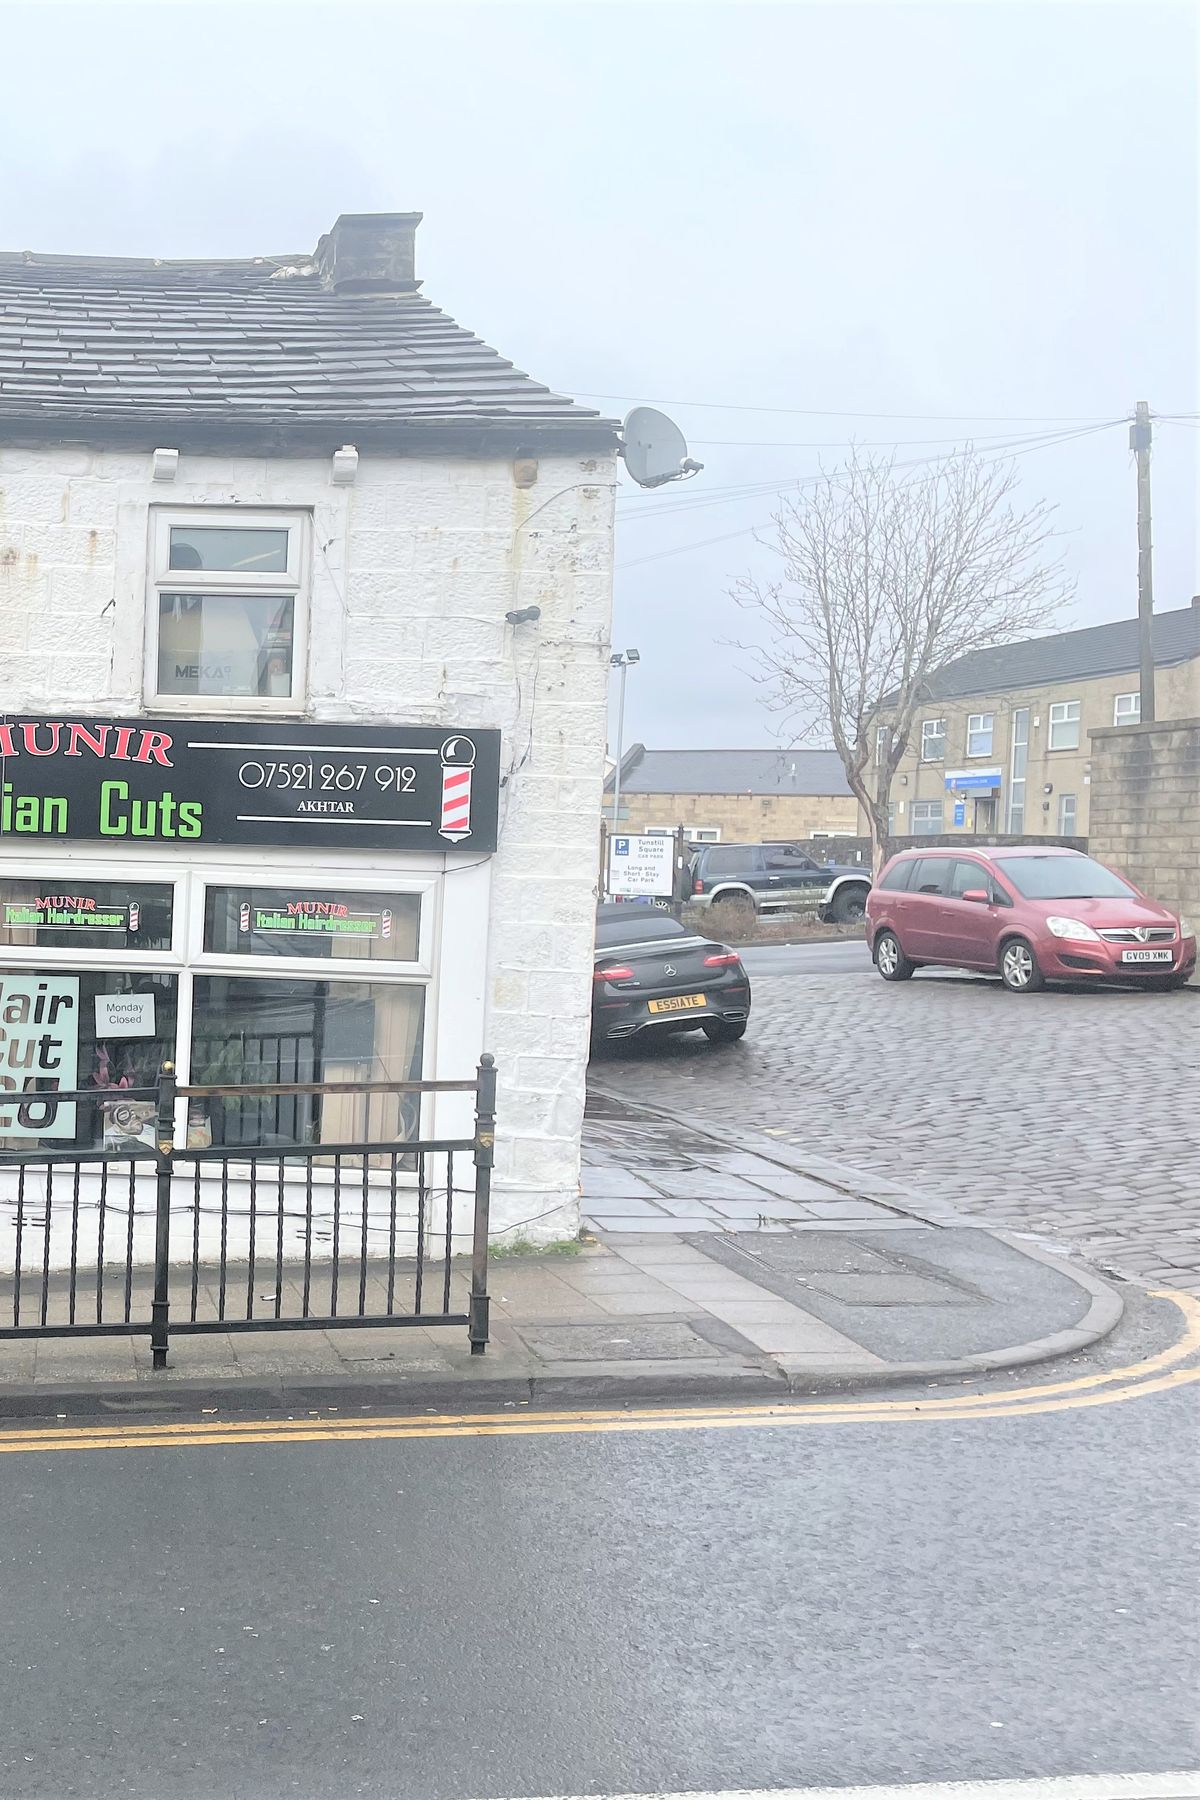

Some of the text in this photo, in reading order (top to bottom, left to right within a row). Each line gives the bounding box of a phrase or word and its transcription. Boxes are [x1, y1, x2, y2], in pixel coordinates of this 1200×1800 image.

[238, 761, 417, 793] 07521 267 912
[99, 780, 203, 839] Cuts
[296, 800, 354, 813] AKHTAR
[35, 895, 96, 911] MUNIR
[286, 901, 349, 918] MUNIR
[256, 911, 296, 929] Italian
[1126, 951, 1151, 961] GV09
[106, 1003, 144, 1014] Monday
[109, 1015, 142, 1025] Closed
